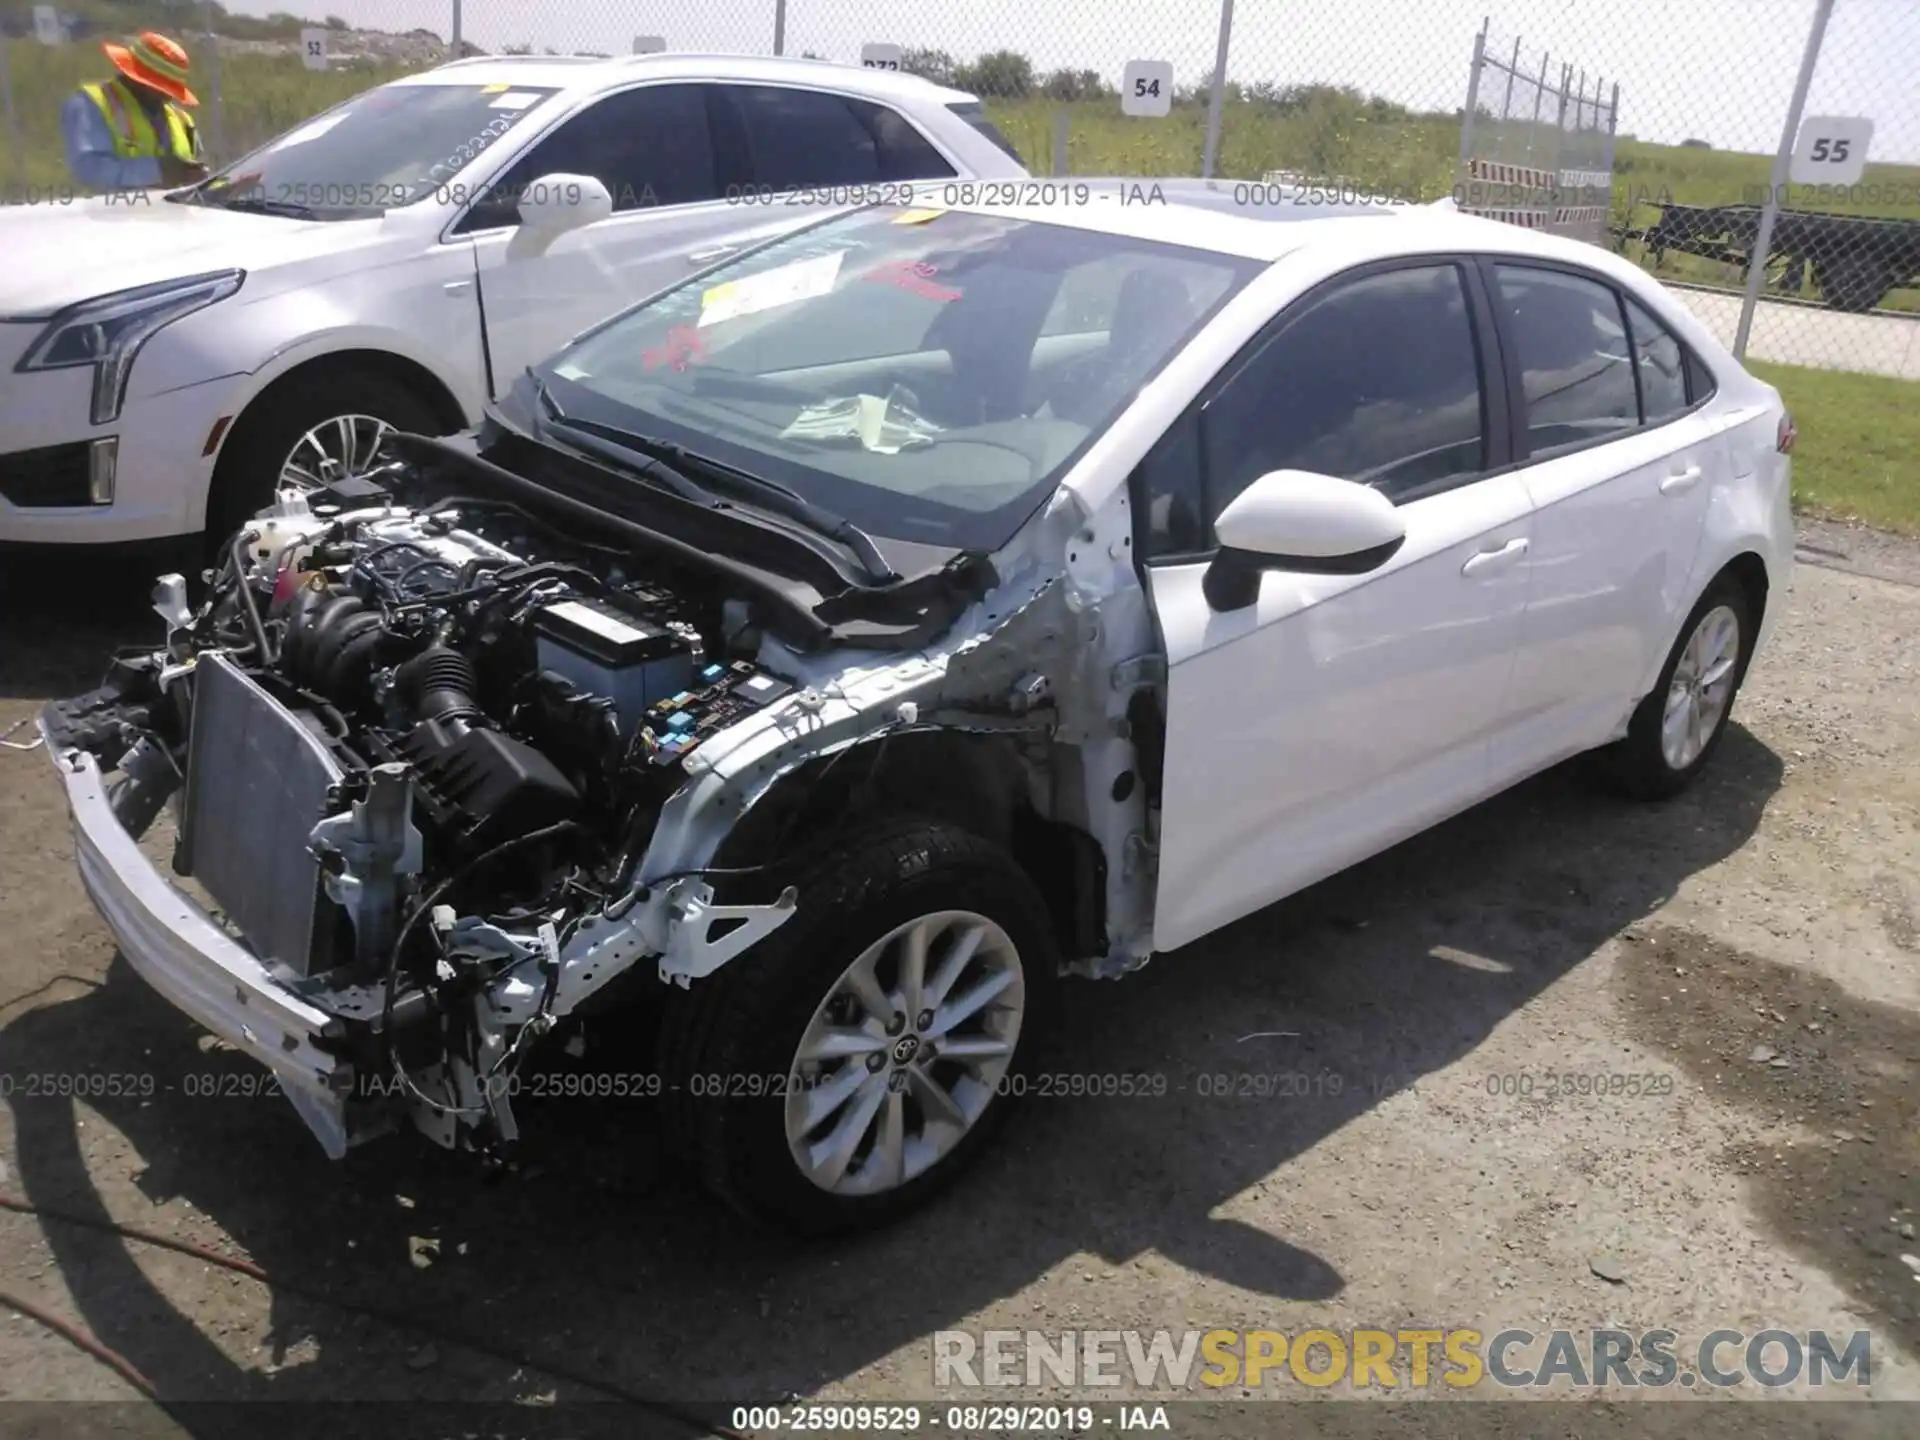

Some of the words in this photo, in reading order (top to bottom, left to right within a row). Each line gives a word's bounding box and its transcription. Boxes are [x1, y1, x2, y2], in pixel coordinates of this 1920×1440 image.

[308, 41, 321, 56] 52
[1135, 78, 1160, 98] 54
[1810, 138, 1850, 163] 55
